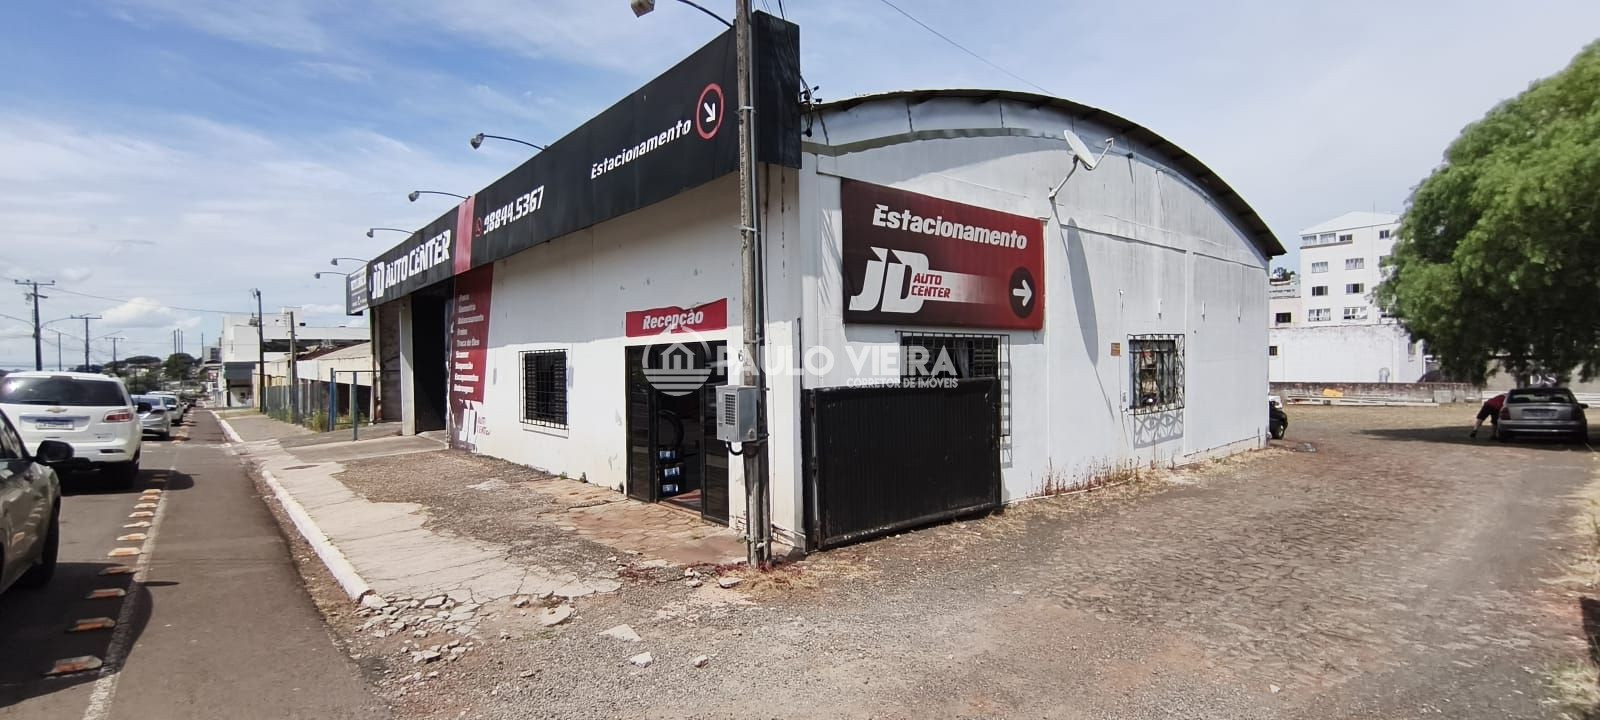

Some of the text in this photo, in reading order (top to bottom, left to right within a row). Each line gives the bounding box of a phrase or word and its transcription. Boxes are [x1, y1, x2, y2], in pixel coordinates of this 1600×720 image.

[590, 119, 692, 180] Estacionamento
[872, 203, 1028, 250] Estacionamento
[369, 261, 385, 300] JD
[385, 254, 408, 289] AUTO
[408, 229, 452, 277] CENTER
[848, 246, 930, 314] JD
[912, 272, 943, 287] AUTO
[911, 285, 951, 299] CENTER
[642, 309, 704, 330] Recepção
